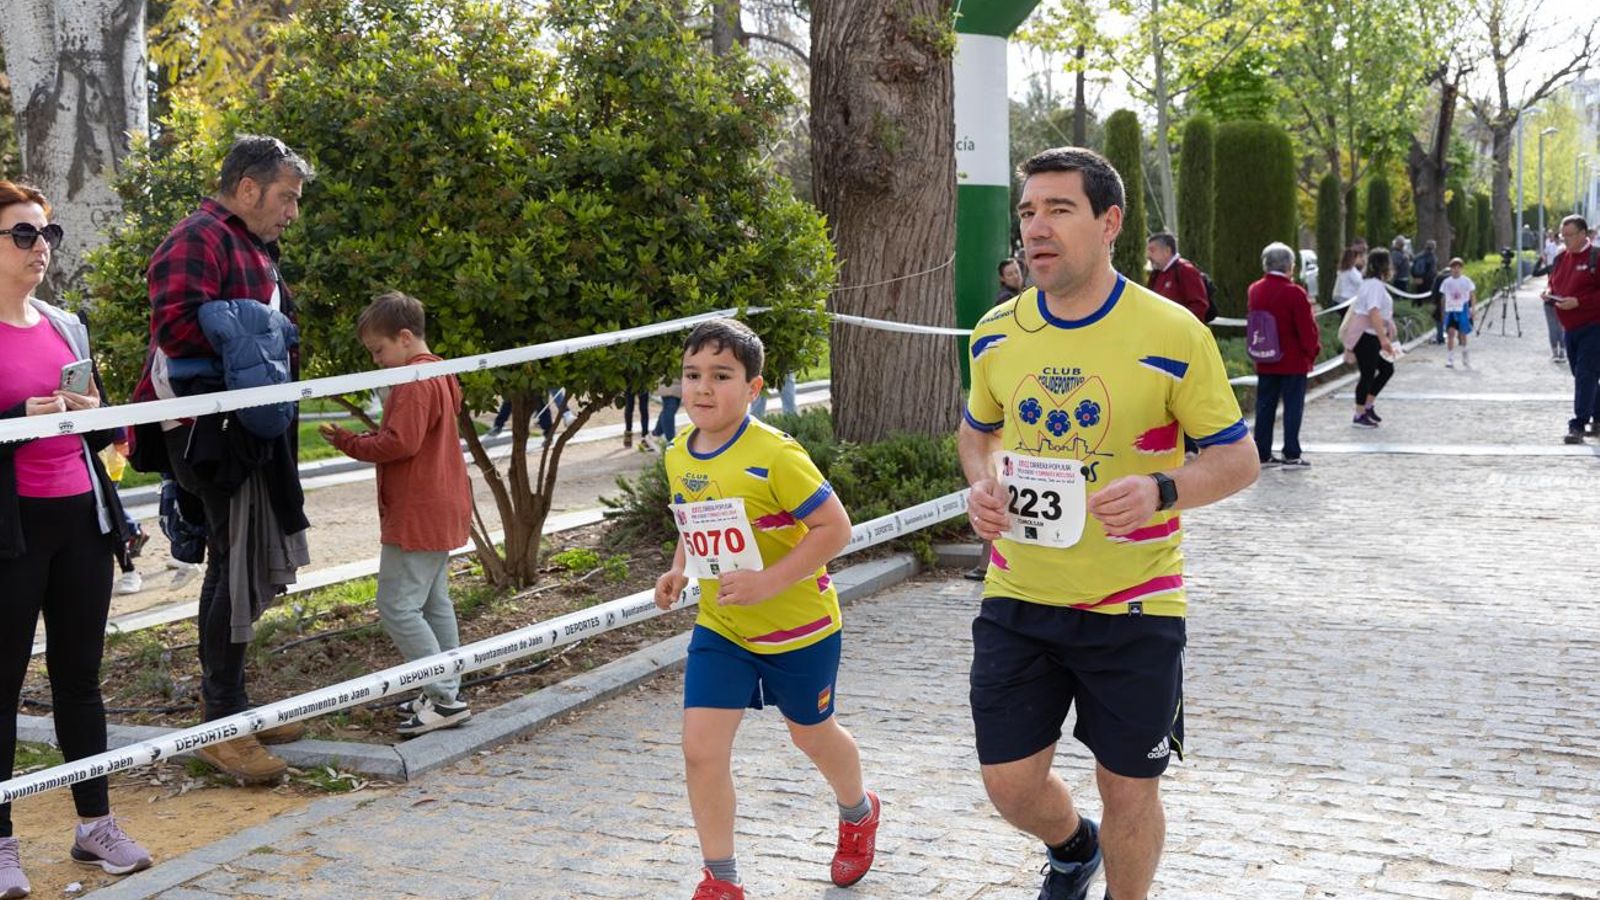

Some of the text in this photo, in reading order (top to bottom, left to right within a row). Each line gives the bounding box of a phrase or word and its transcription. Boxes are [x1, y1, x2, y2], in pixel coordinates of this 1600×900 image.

[1043, 367, 1081, 375] CLUB
[686, 472, 708, 480] CLUB
[1008, 484, 1062, 521] 223
[683, 527, 745, 557] 5070
[564, 616, 601, 636] DEPORTES
[474, 642, 518, 664] Ayuntamiento
[519, 640, 527, 650] de
[400, 663, 446, 686] DEPORTES
[277, 697, 337, 723] Ayuntamiento
[338, 693, 349, 704] de
[175, 723, 239, 752] DEPORTES
[3, 768, 87, 800] Ayuntamiento
[90, 763, 104, 777] de
